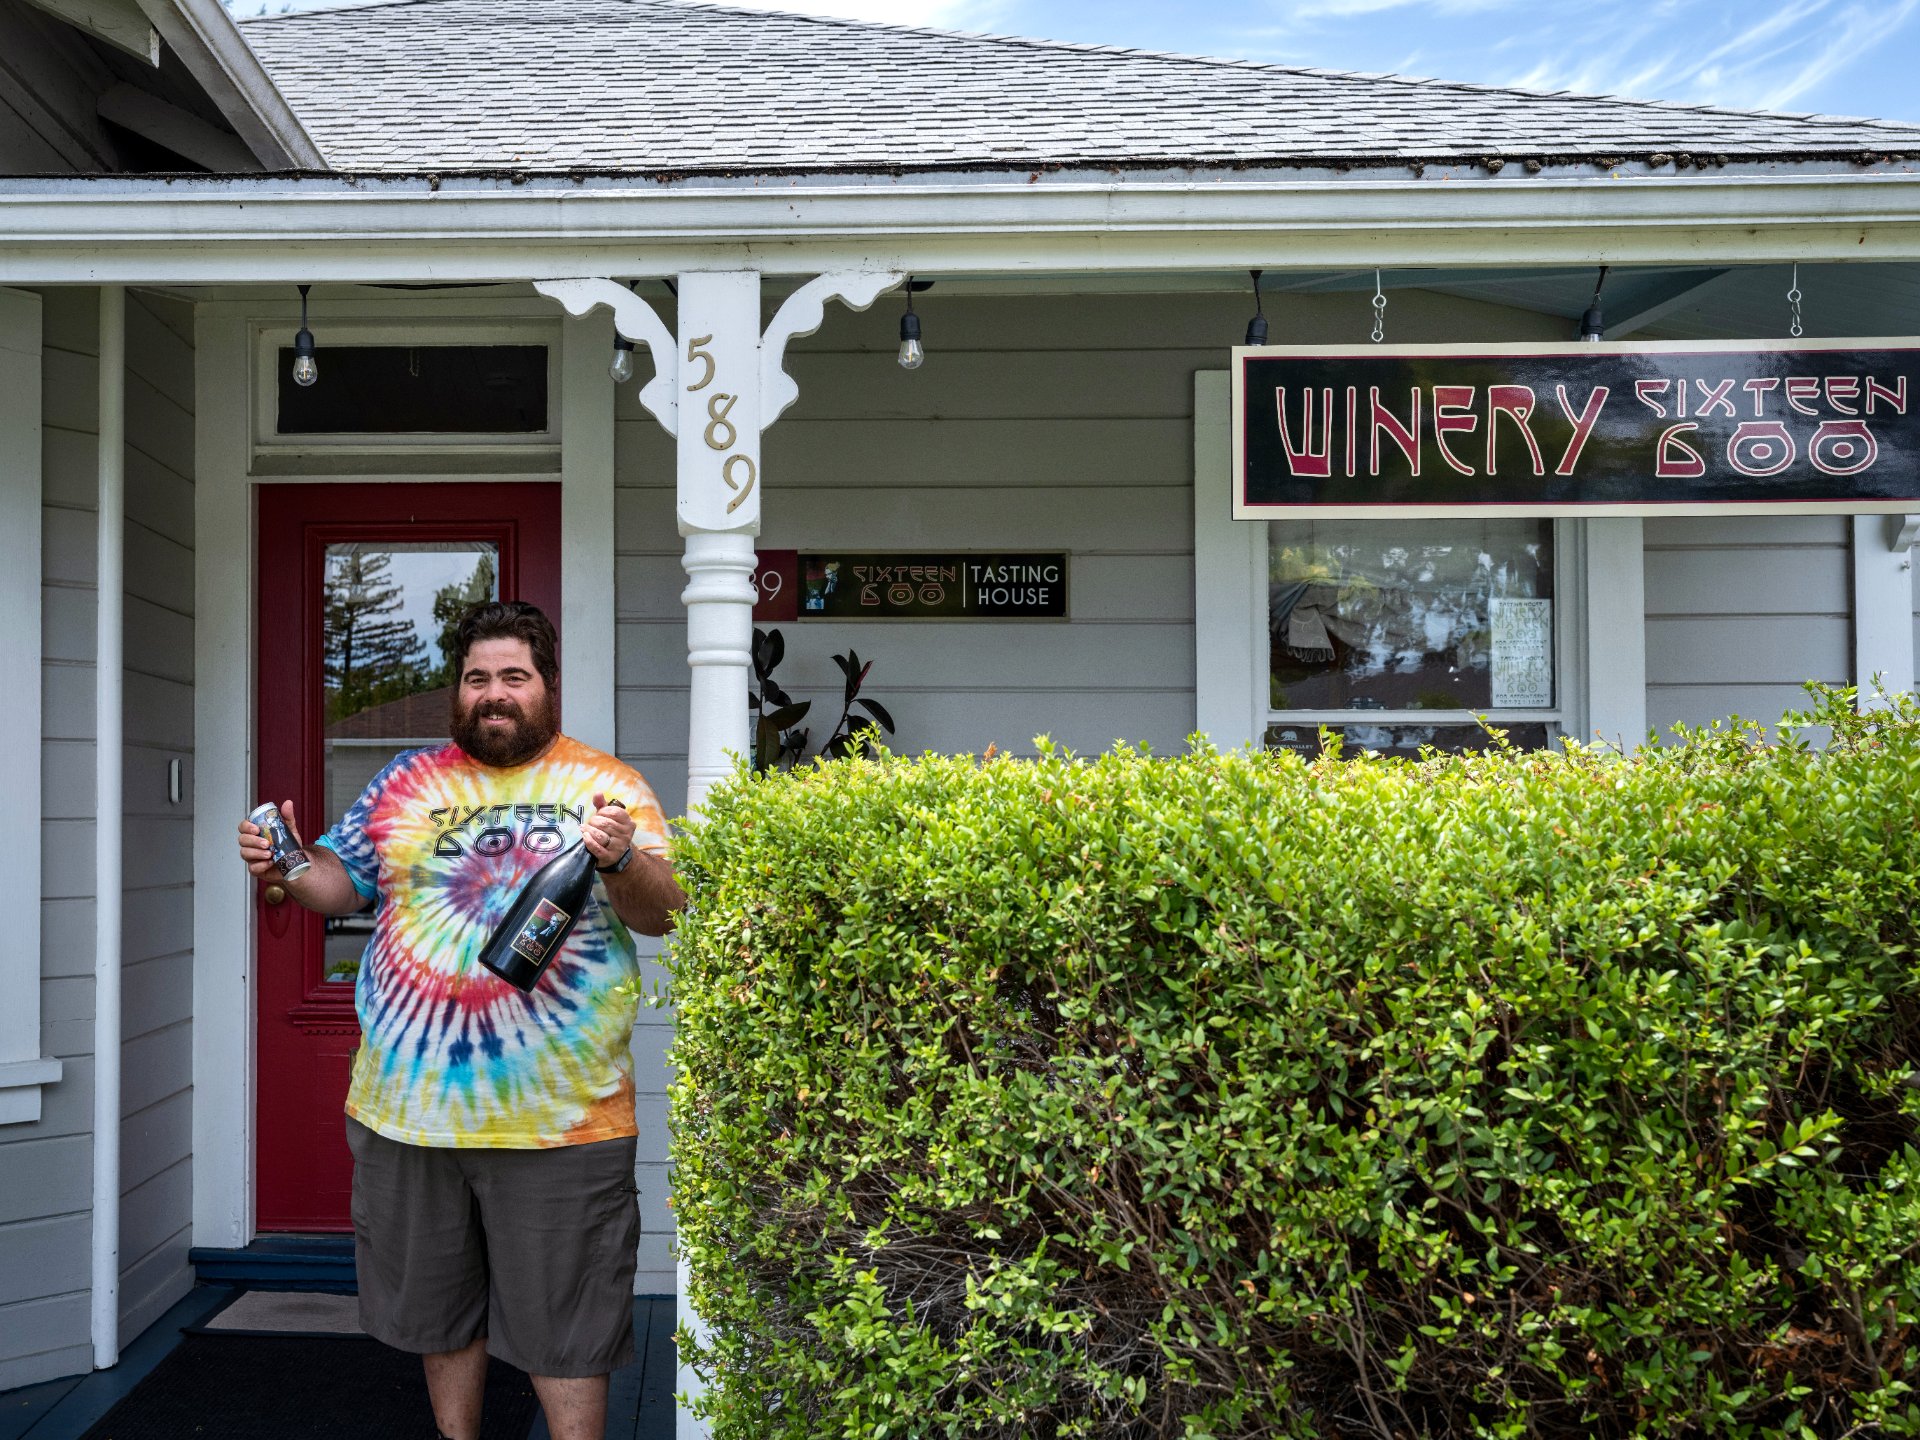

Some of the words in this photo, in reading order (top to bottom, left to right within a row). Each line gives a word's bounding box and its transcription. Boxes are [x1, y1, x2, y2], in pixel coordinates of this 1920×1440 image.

[1634, 376, 1907, 418] SIXTEEN
[687, 333, 756, 515] 589
[1276, 385, 1609, 477] WINERY
[1655, 419, 1878, 478] 600
[852, 565, 957, 583] SIXTEEN
[970, 565, 1059, 584] TASTING
[861, 583, 945, 605] 600
[978, 587, 1049, 606] HOUSE
[428, 804, 584, 827] SIXTEEN
[433, 825, 566, 858] 600
